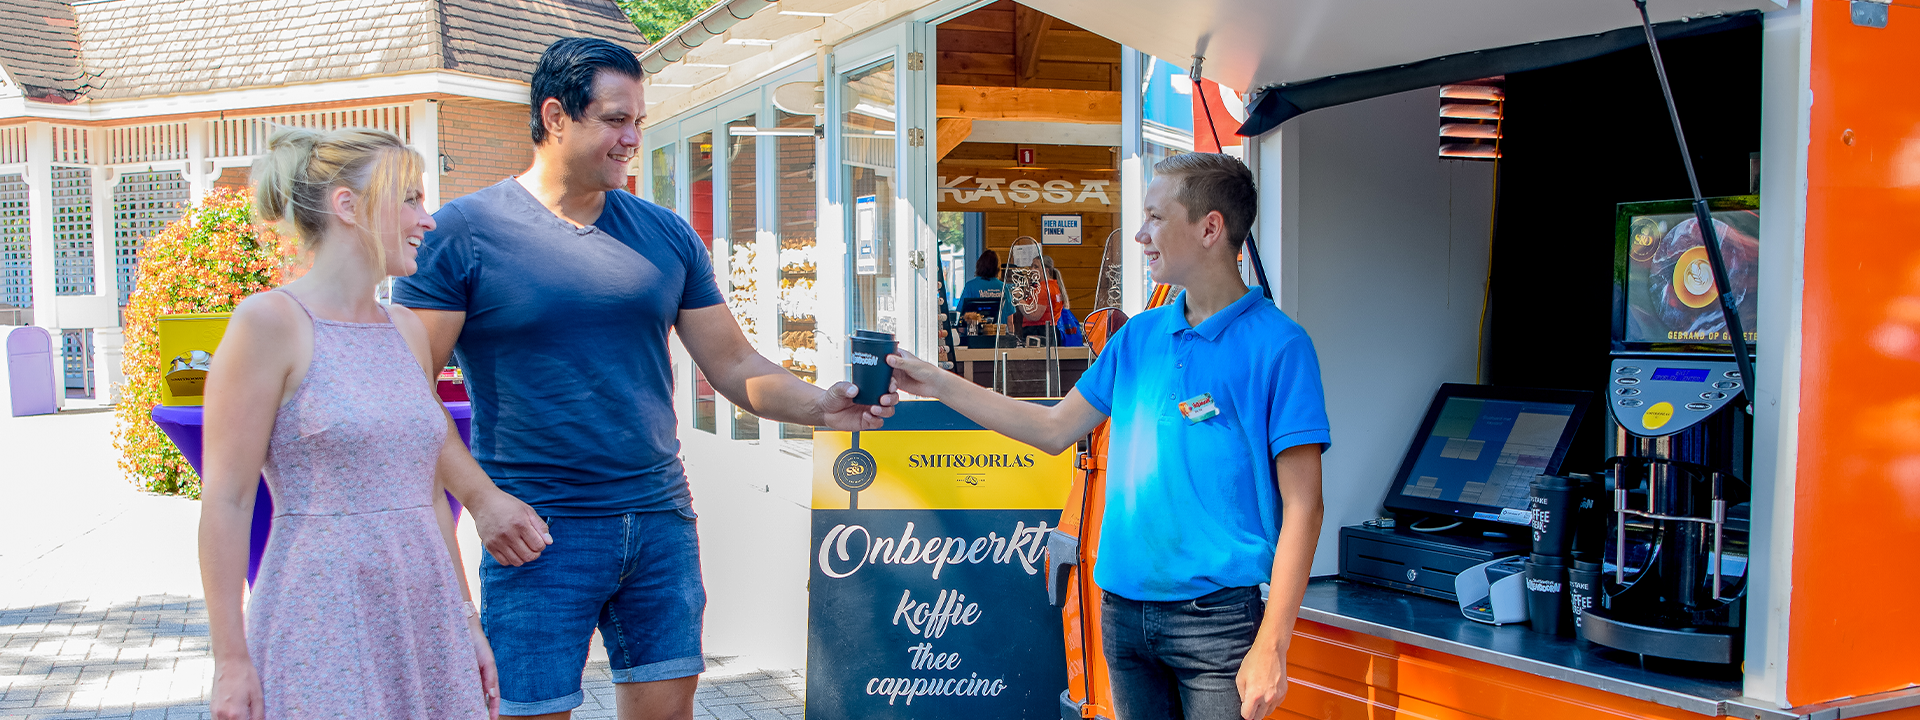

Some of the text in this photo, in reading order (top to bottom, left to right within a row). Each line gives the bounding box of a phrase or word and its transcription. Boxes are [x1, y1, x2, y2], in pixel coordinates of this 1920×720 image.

[938, 175, 1111, 205] KASSA
[1044, 220, 1078, 228] HIER ALLEEN
[1044, 227, 1065, 235] PINNEN
[1667, 331, 1705, 340] GEBRAND
[1708, 331, 1720, 340] OP
[908, 453, 1035, 468] SMIT&DORLAS
[818, 520, 1058, 579] Onbeperkt
[892, 589, 982, 639] koffie
[907, 642, 962, 670] thee
[866, 672, 1007, 706] cappuccino
